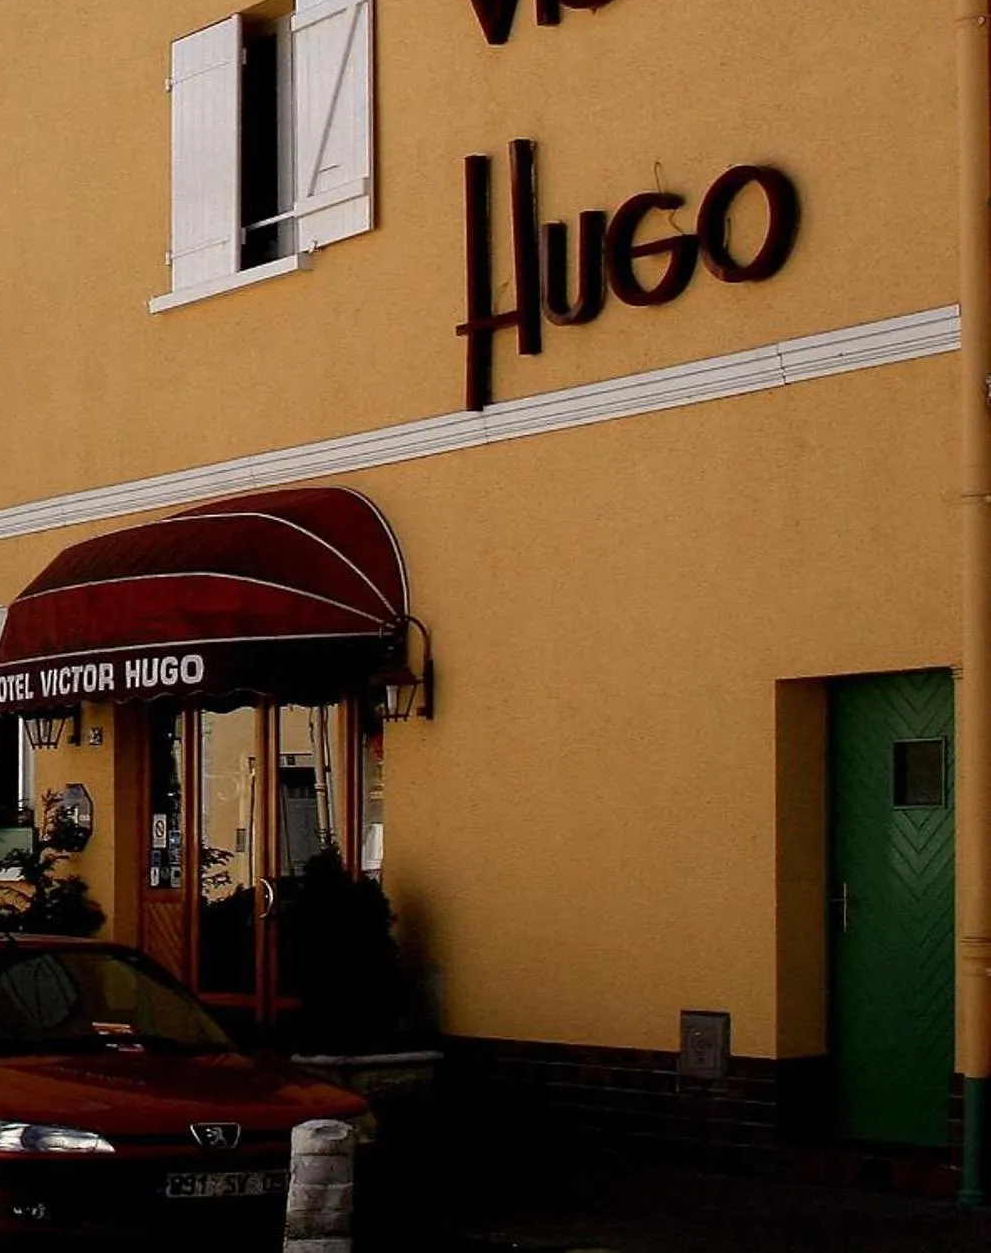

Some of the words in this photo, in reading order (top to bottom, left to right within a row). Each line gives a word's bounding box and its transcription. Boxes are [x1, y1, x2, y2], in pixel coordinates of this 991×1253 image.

[455, 139, 801, 412] HUGO
[40, 663, 114, 697] VICTOR
[125, 654, 205, 689] HUGO
